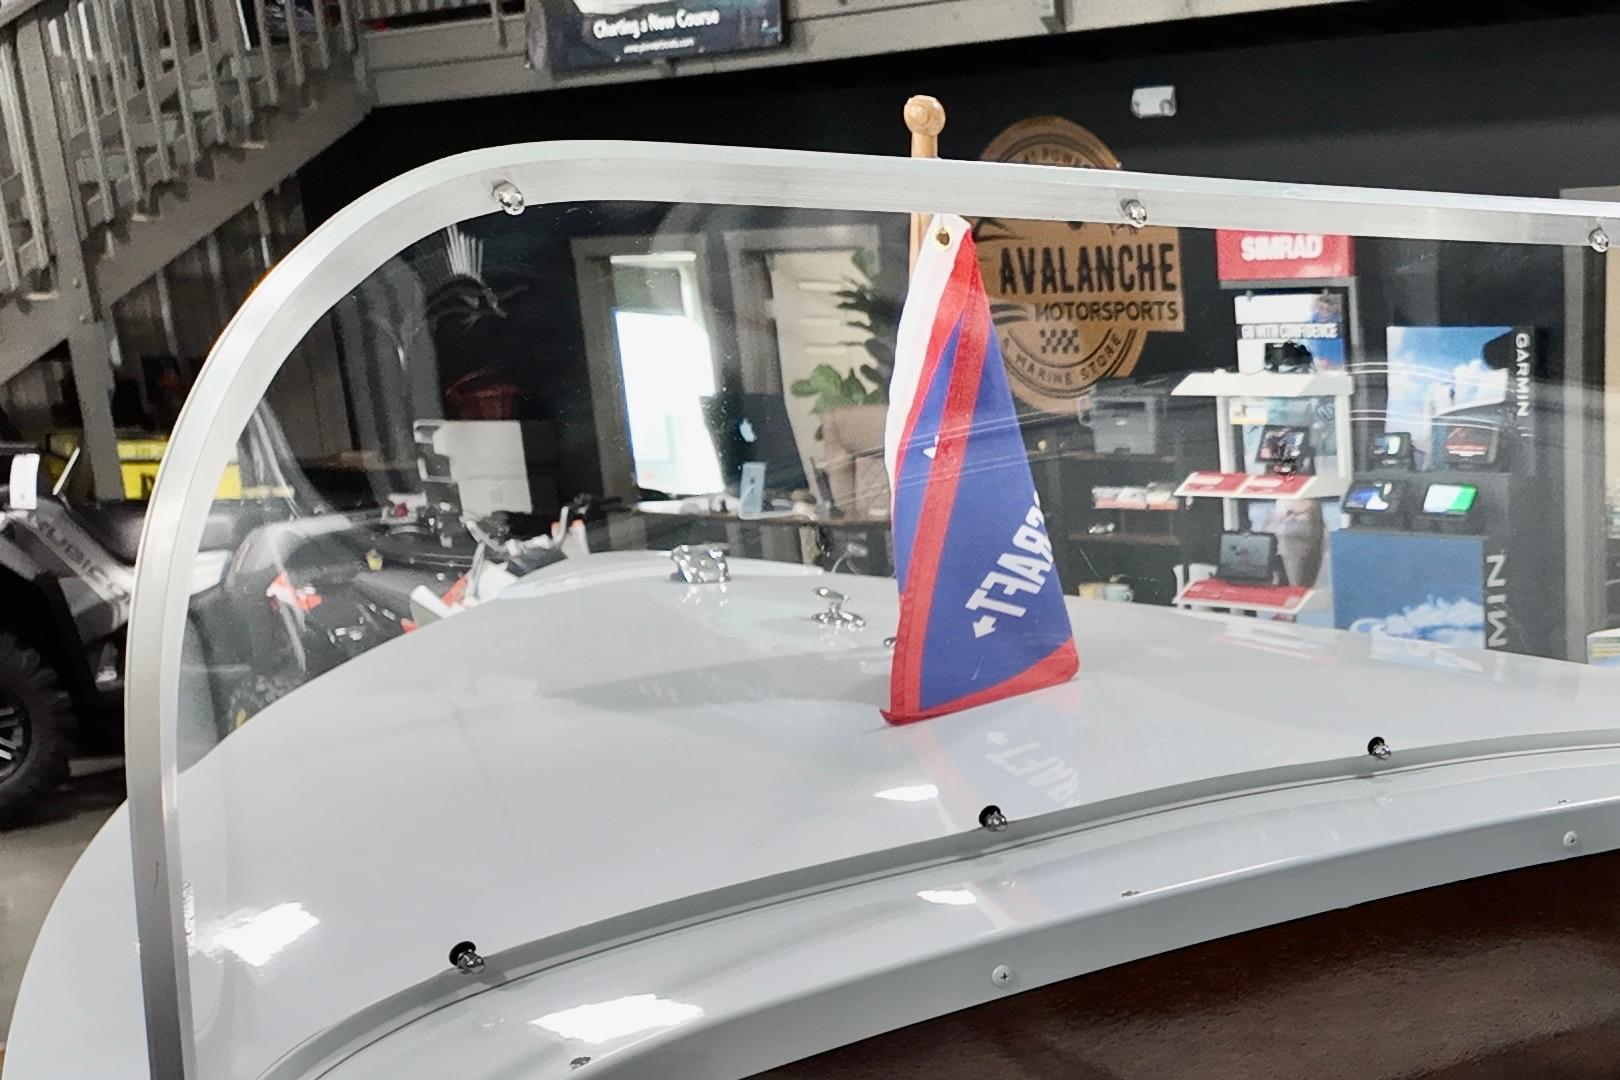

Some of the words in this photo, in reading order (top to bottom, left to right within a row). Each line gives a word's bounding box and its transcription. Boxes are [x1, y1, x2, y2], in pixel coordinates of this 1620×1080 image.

[593, 18, 640, 39] Charting
[648, 12, 675, 31] New
[676, 8, 720, 28] Course
[1241, 233, 1323, 261] SIMRAD
[1000, 243, 1177, 295] AVALANCHE
[1034, 301, 1178, 321] MOTORSPORTS
[1014, 352, 1073, 387] MARINE
[1080, 332, 1123, 382] STORE
[1515, 333, 1531, 417] GARMIN
